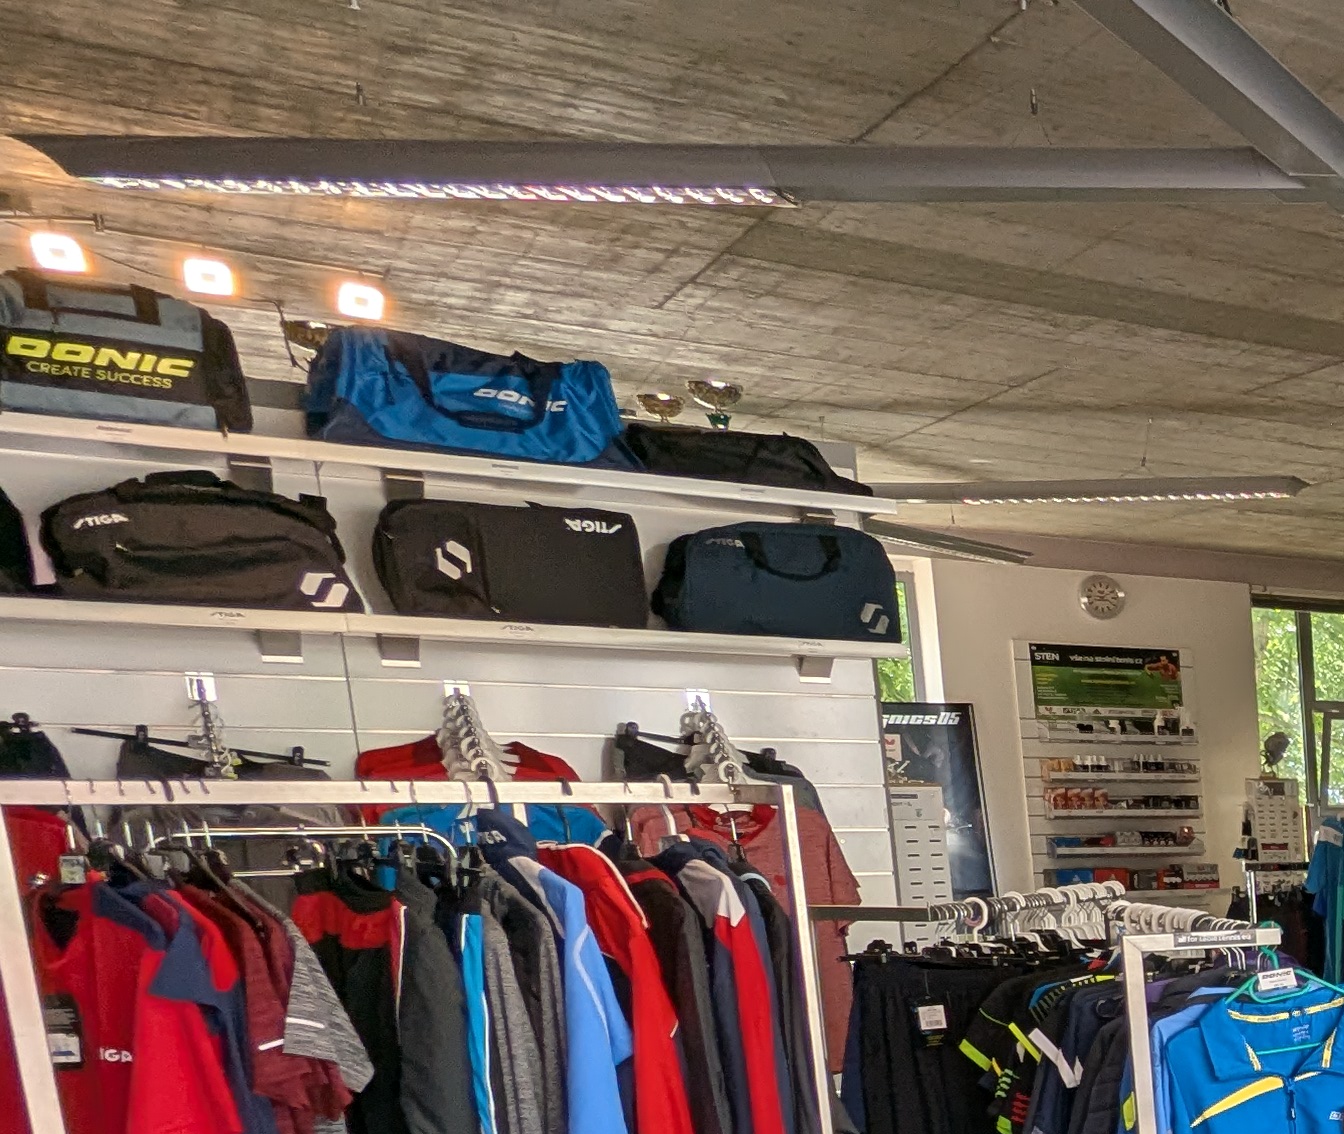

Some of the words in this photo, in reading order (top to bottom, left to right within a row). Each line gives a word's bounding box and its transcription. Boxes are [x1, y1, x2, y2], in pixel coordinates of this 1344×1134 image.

[7, 335, 195, 378] DONIC
[26, 360, 91, 379] CREATE
[96, 370, 173, 389] SUCCESS
[71, 513, 130, 529] STIGA
[563, 517, 622, 534] STIGA
[1034, 652, 1060, 661] STEN
